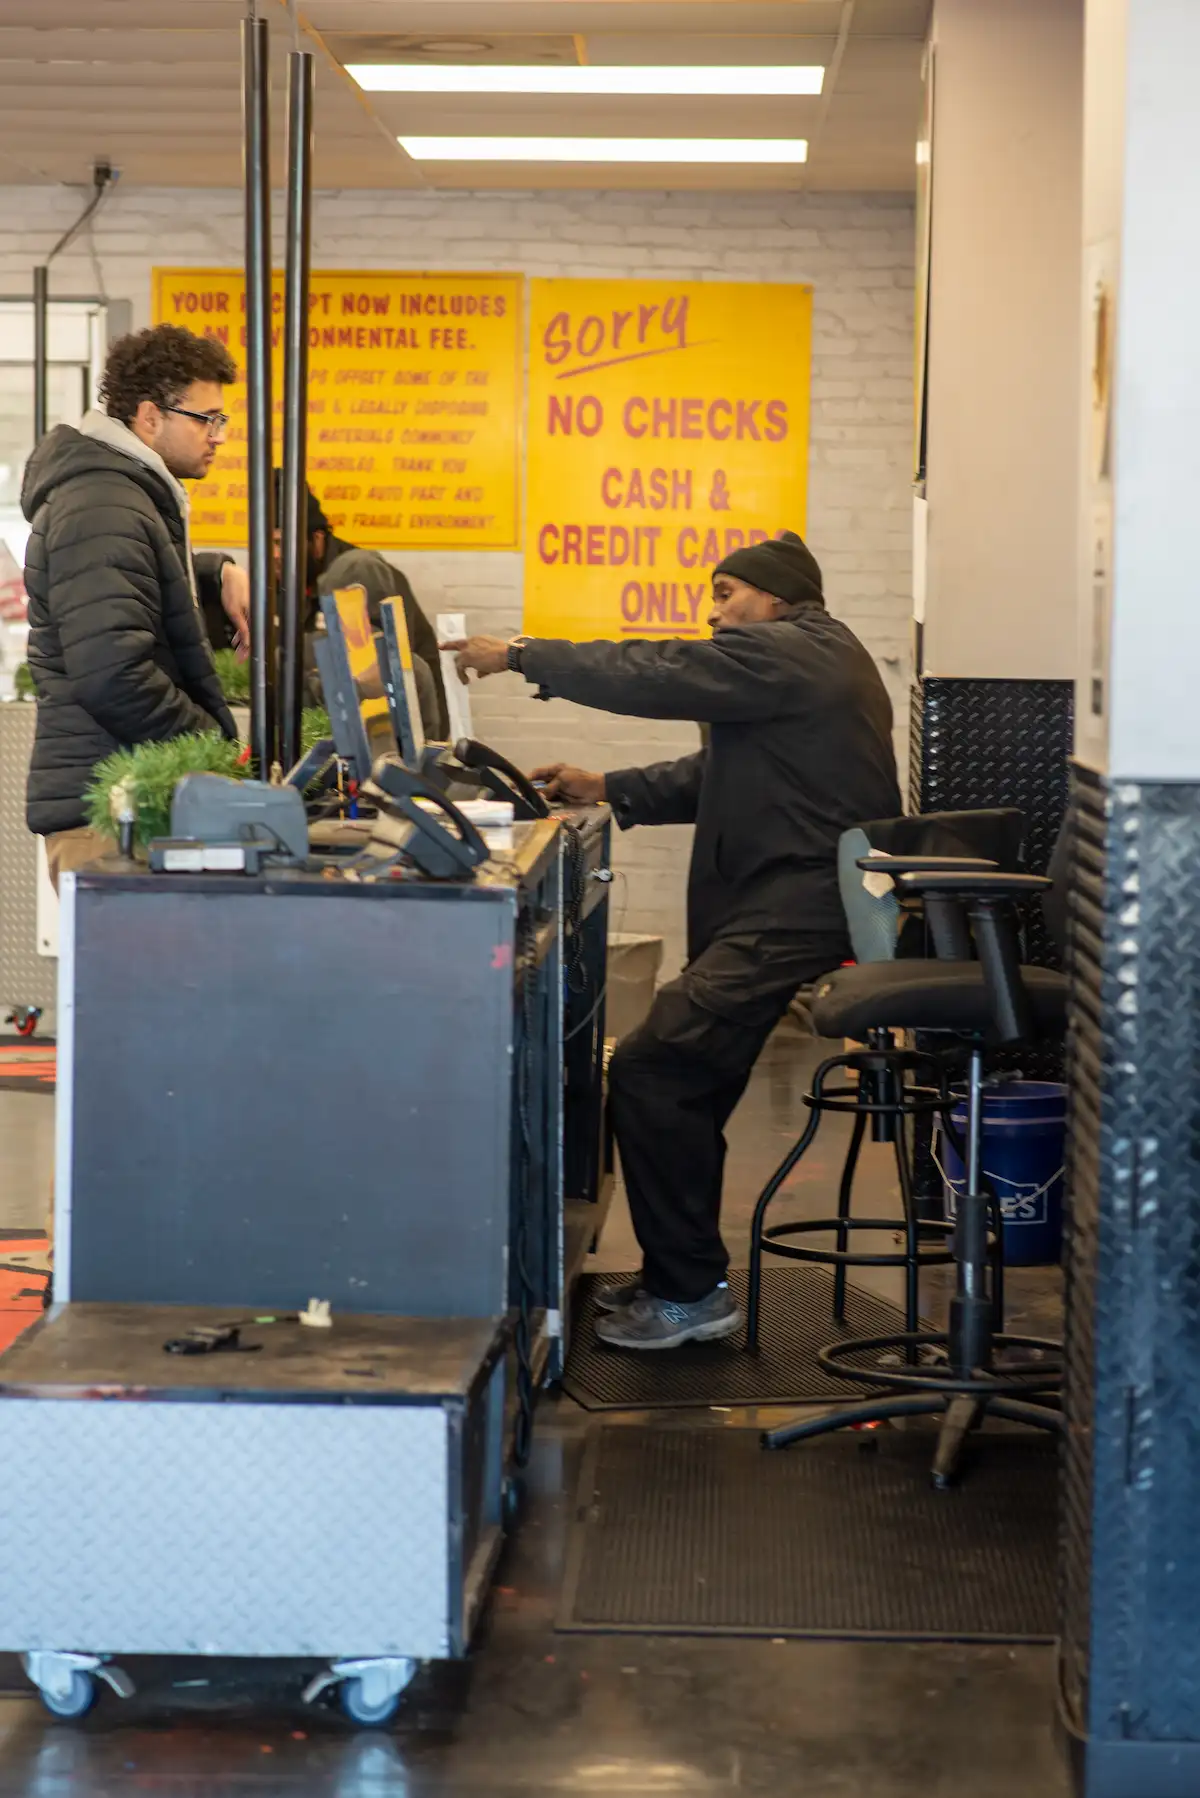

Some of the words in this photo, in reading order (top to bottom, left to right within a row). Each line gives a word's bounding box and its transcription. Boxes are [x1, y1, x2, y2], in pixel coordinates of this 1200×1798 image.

[172, 291, 230, 314] YOUR
[341, 292, 390, 316] NOW
[401, 292, 507, 317] INCLUDES
[429, 327, 477, 350] FEE.
[542, 296, 690, 365] Sorry
[547, 394, 604, 438] NO
[622, 395, 789, 443] CHECKS
[601, 466, 693, 511] CASH
[708, 468, 732, 511] &
[537, 523, 662, 567] CREDIT
[676, 526, 788, 569] CAR
[620, 580, 706, 624] ONLY
